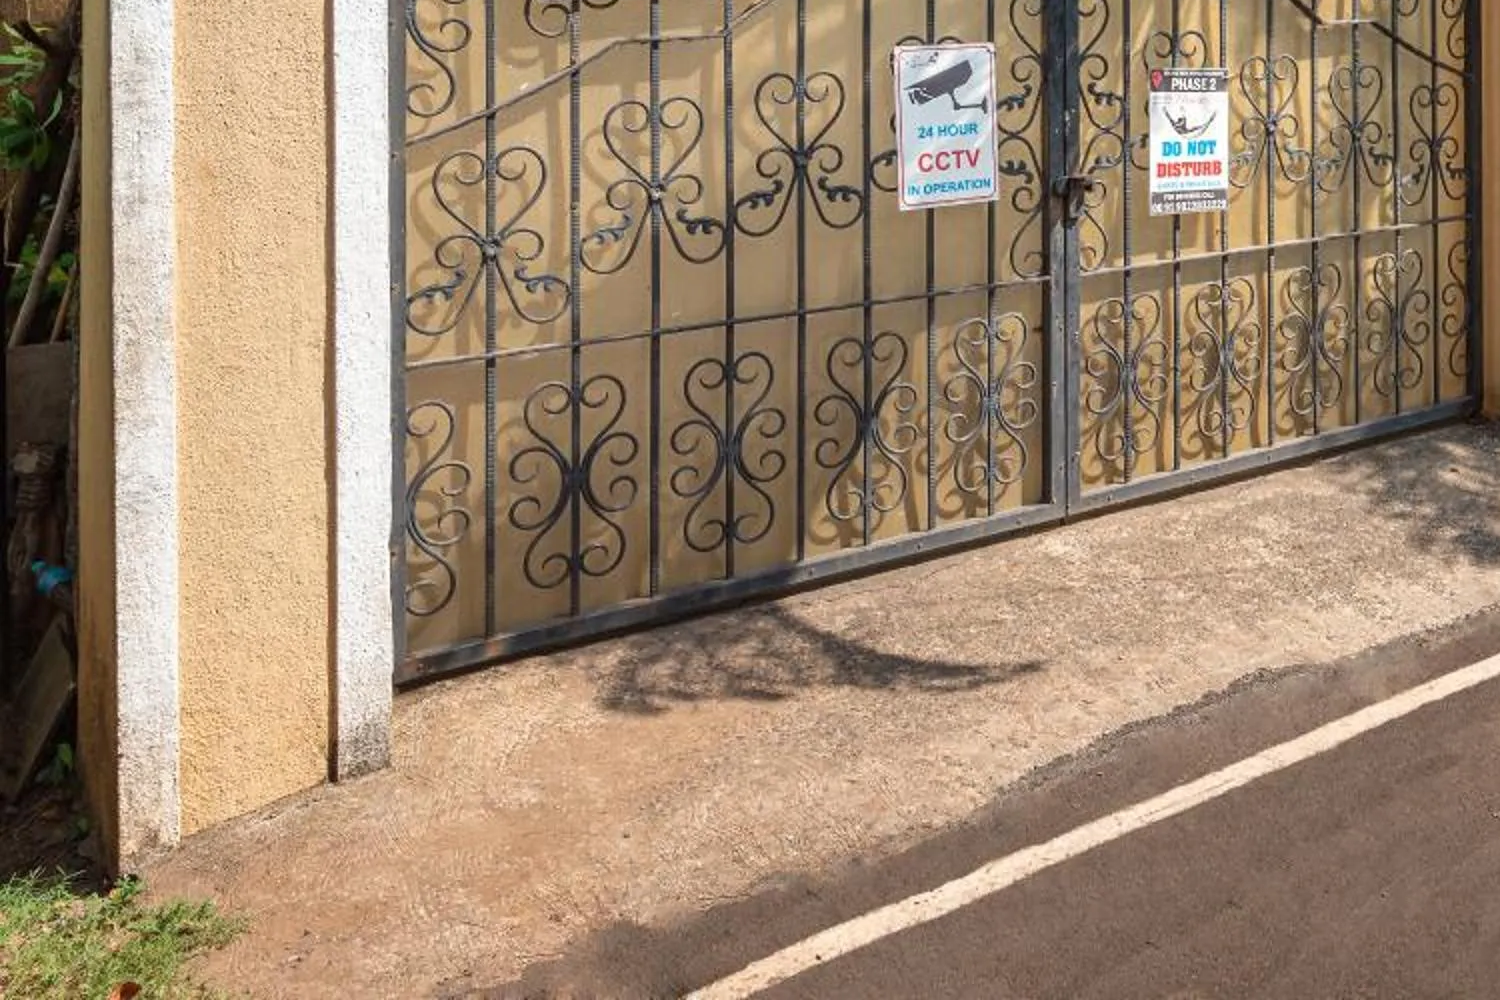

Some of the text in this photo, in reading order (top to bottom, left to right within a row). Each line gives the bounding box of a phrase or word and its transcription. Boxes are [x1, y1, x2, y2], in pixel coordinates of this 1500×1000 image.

[1171, 77, 1217, 91] PHASE 2
[917, 123, 979, 139] 24 HOUR
[1161, 139, 1217, 157] DO NOT
[917, 149, 980, 173] CCTV
[1156, 160, 1222, 178] DISTURB
[908, 178, 991, 196] IN OPERATION
